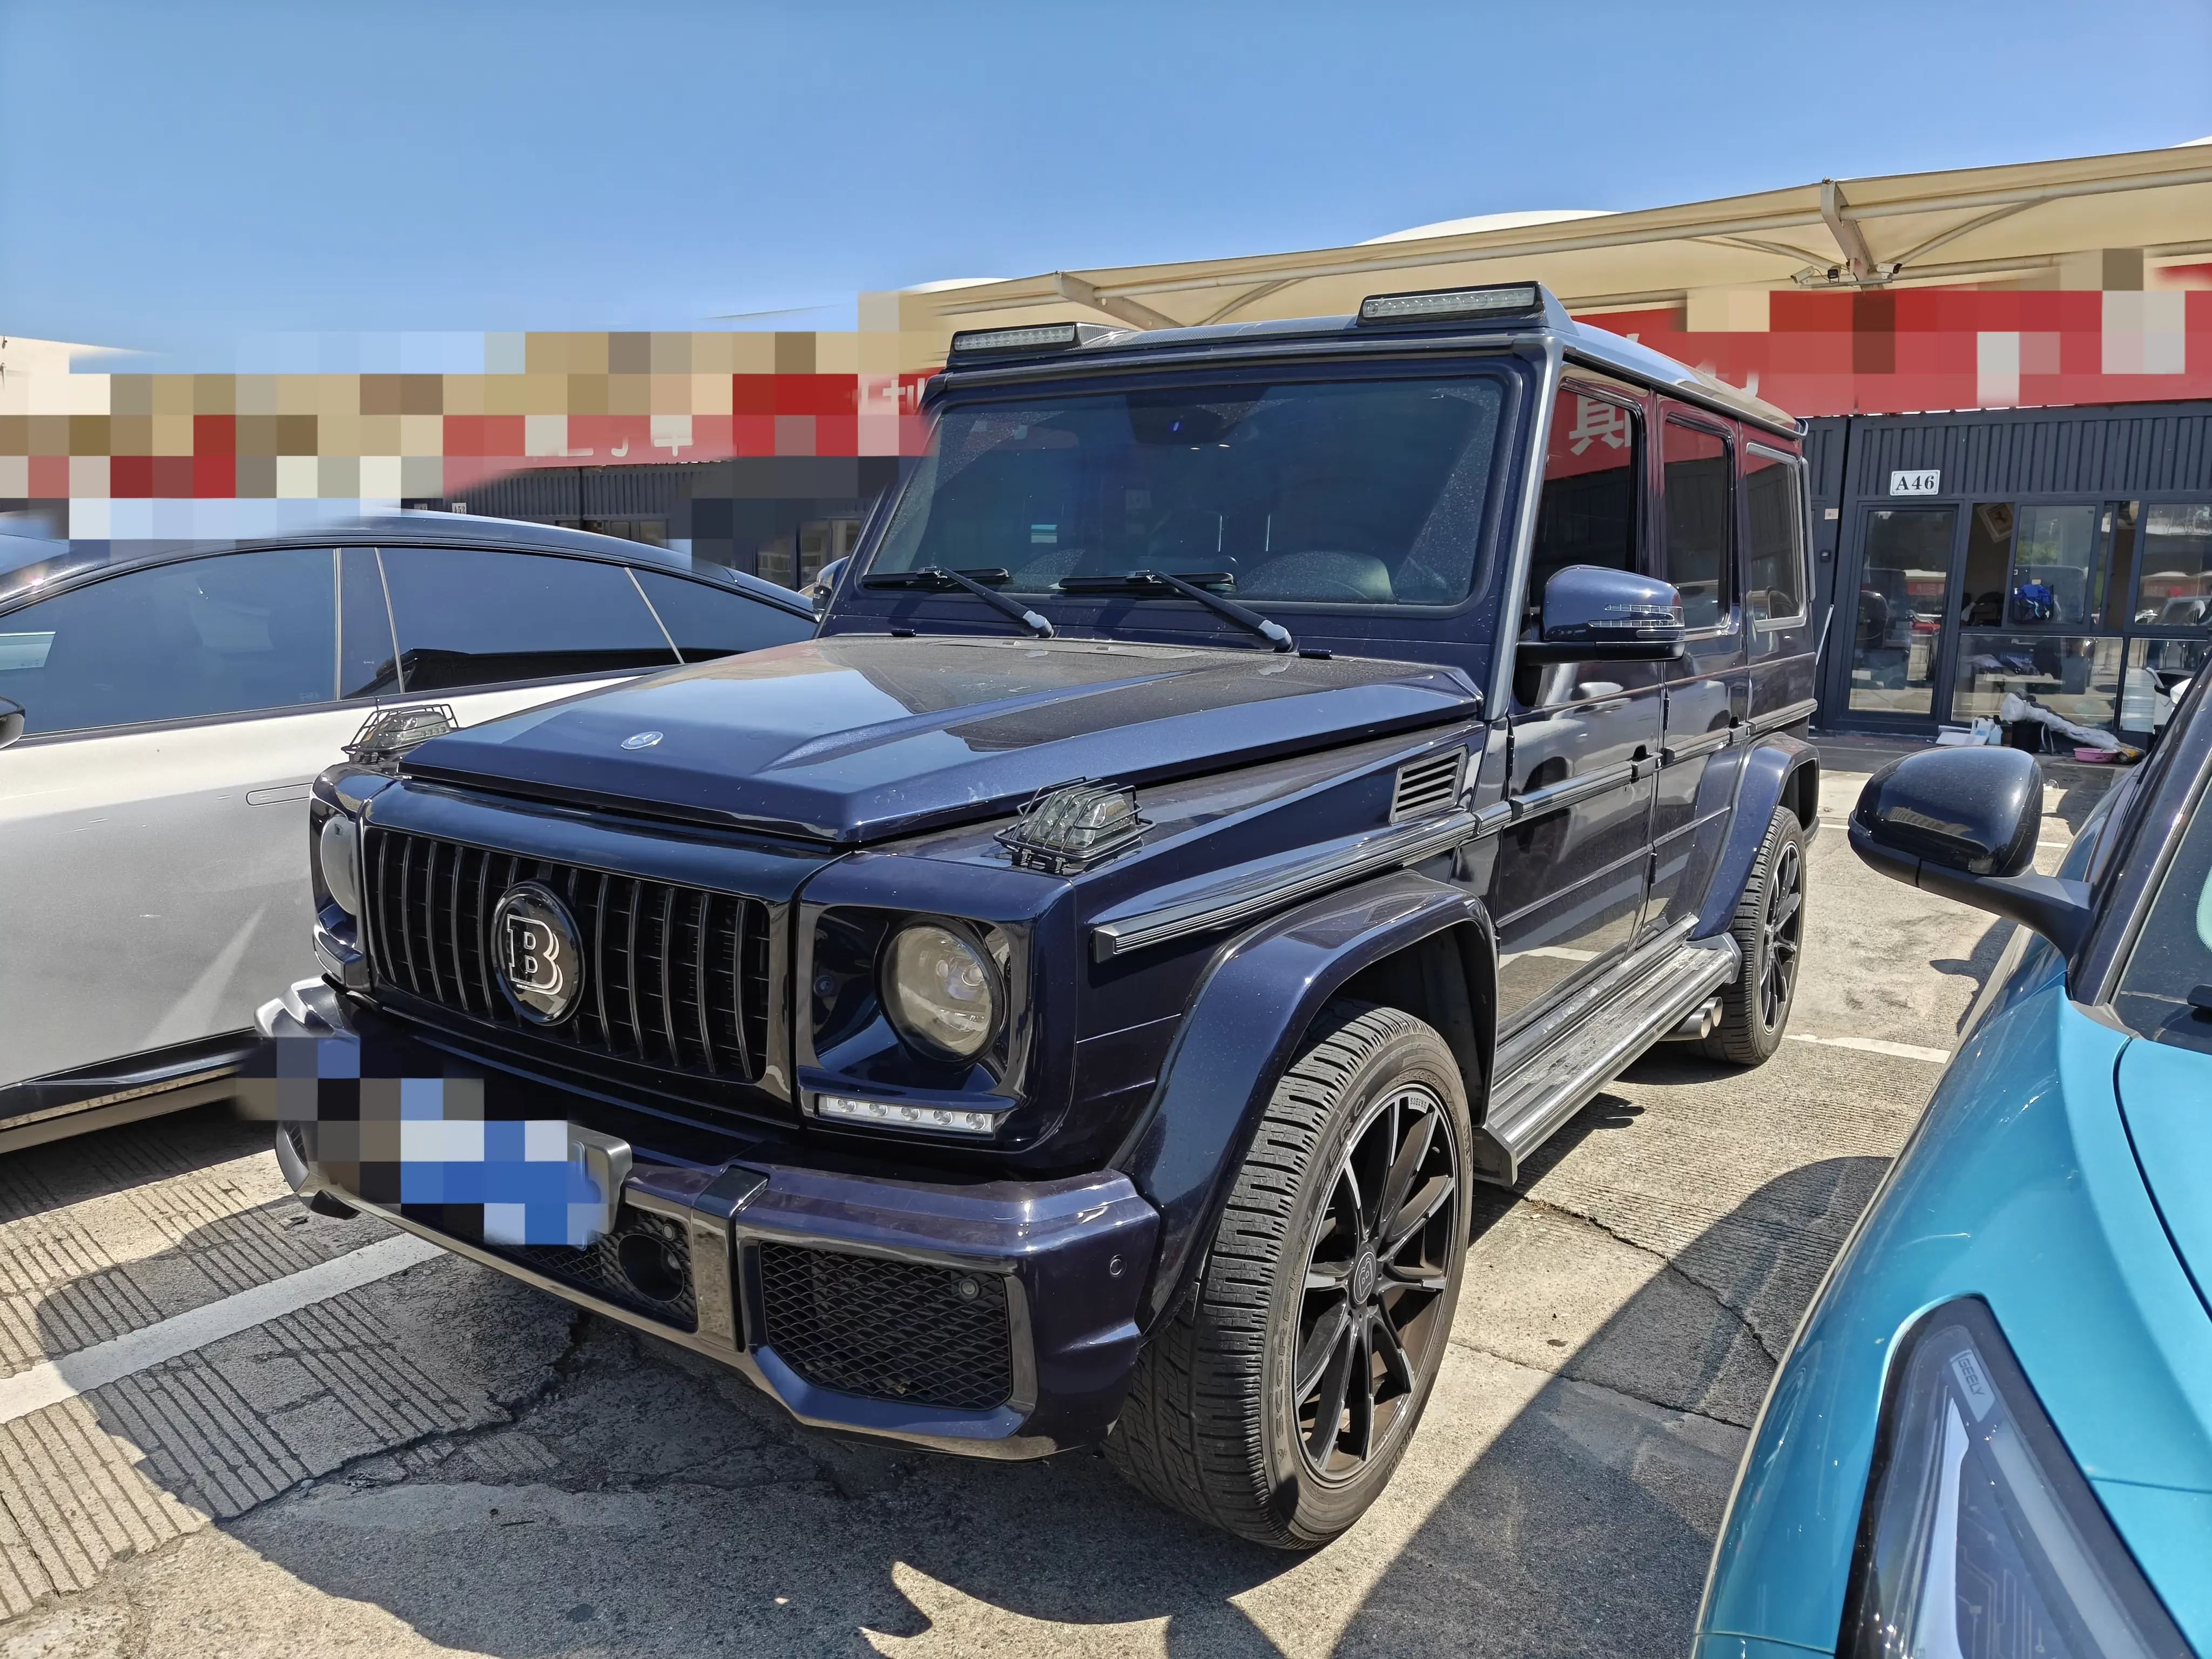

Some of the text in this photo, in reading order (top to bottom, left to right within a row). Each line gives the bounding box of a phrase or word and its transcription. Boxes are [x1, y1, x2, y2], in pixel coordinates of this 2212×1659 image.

[1896, 475, 1934, 490] A46
[1274, 1095, 1366, 1438] SCORPION ZERO
[1958, 1358, 1986, 1395] GEELY
